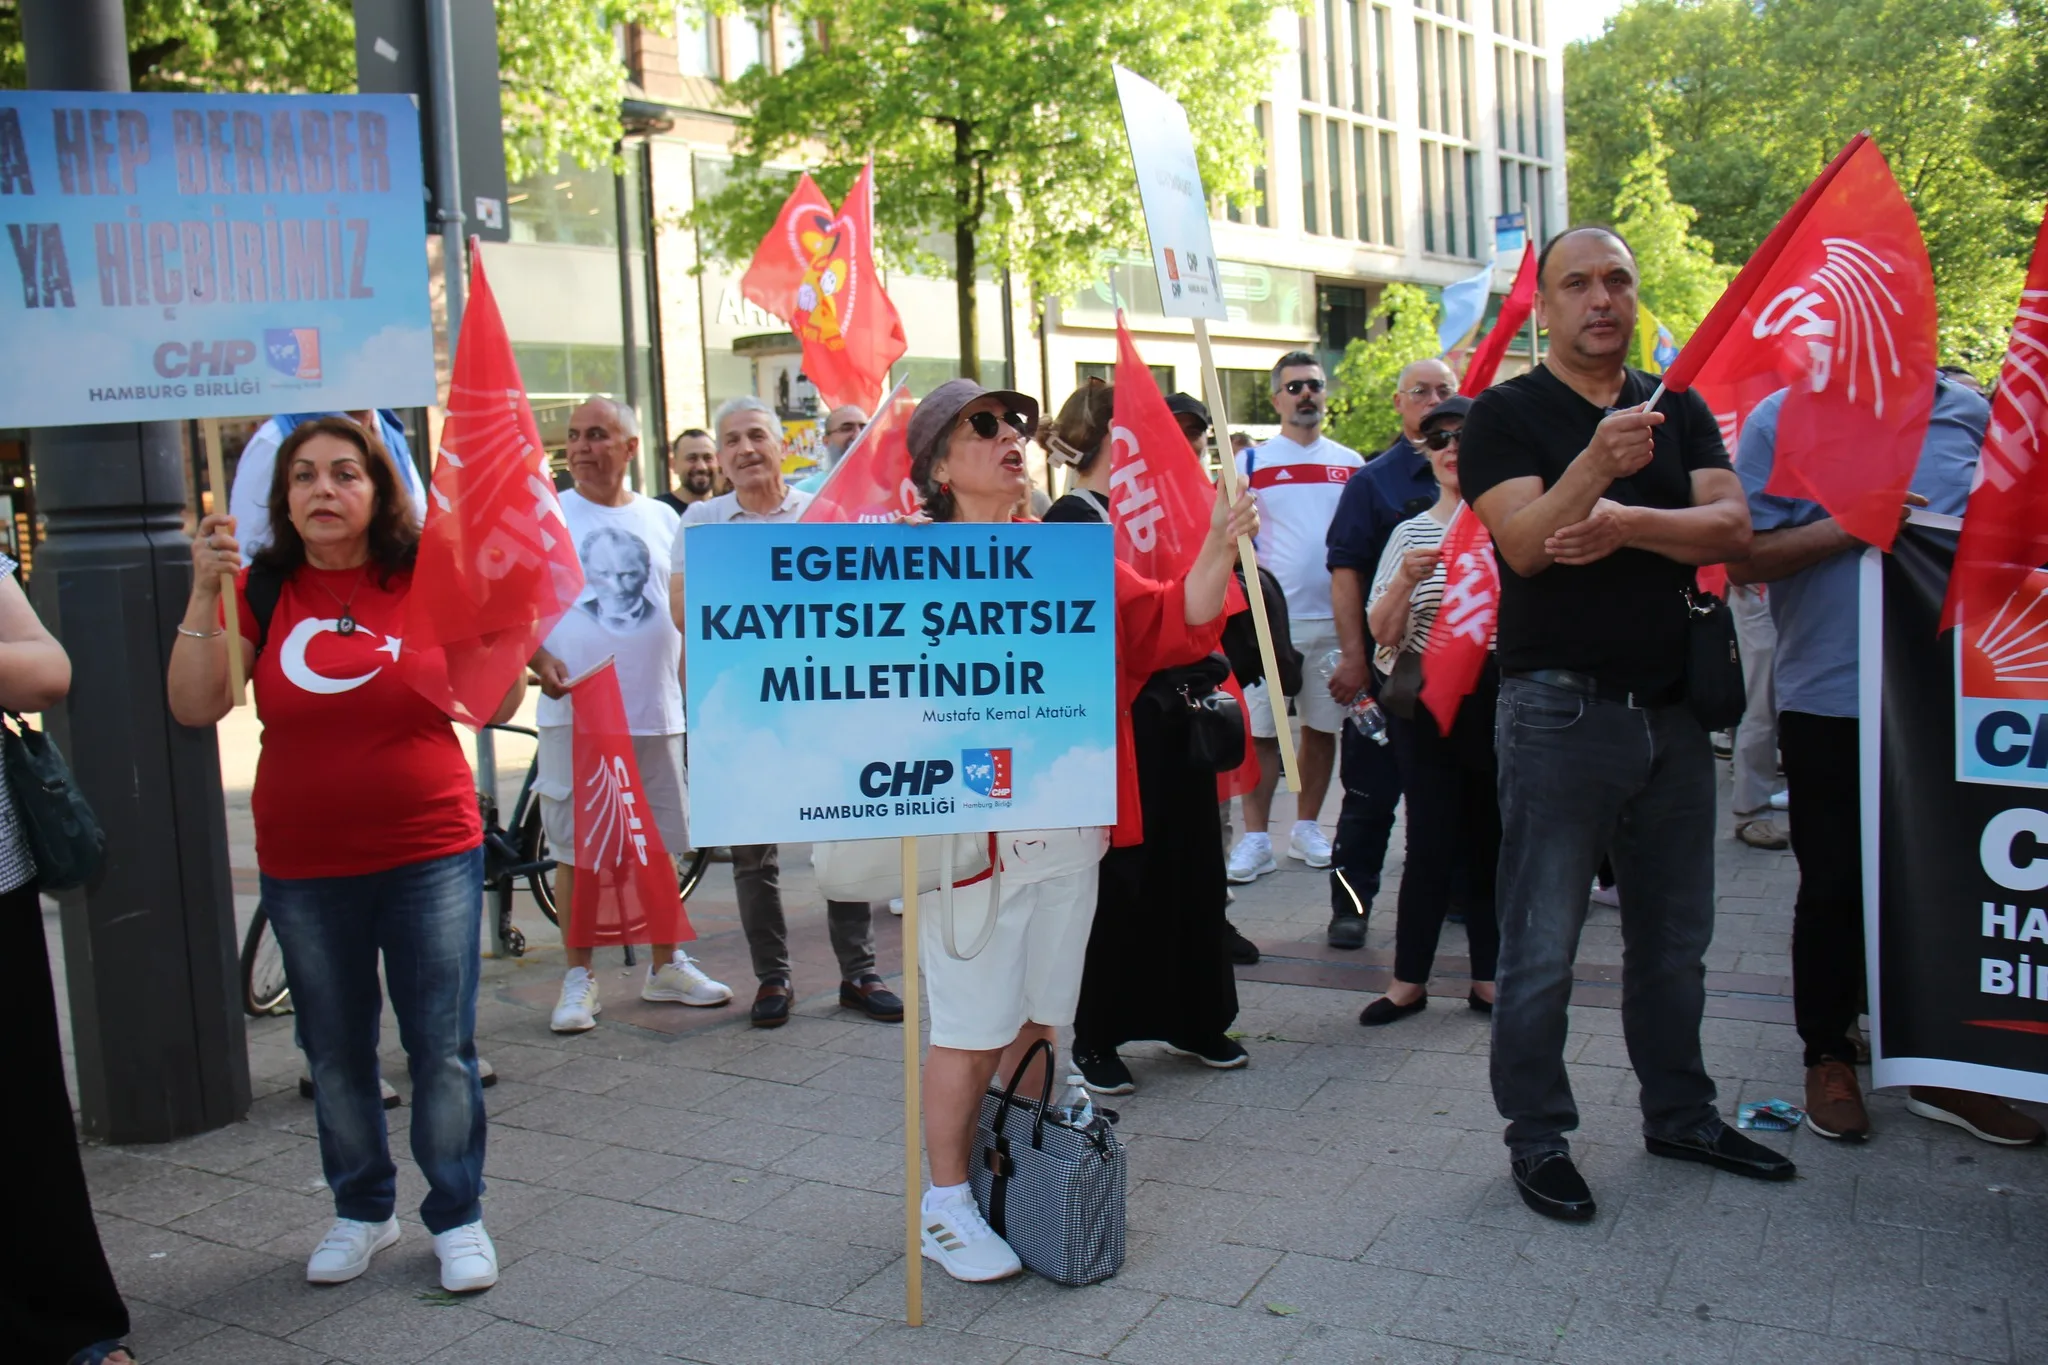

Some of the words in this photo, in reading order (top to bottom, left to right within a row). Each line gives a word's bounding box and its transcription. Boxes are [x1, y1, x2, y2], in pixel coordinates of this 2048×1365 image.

[53, 108, 150, 196] HEP
[173, 109, 391, 195] BERABER
[6, 223, 76, 308] YA
[94, 204, 374, 321] HİÇBİRİMİZ
[153, 339, 257, 379] CHP
[89, 384, 188, 402] HAMBURG
[771, 535, 1033, 582] EGEMENLİK
[702, 603, 905, 641] KAYITSIZ
[922, 599, 1096, 647] ŞARTSIZ
[760, 651, 1045, 702] MİLLETİNDİR
[922, 707, 981, 724] Mustafa
[986, 705, 1031, 721] Kemal
[1035, 704, 1087, 720] Atatürk
[859, 759, 954, 798] CHP
[991, 788, 1011, 797] CHP
[800, 803, 889, 821] HAMBURG
[894, 797, 955, 816] BİRLİĞİ
[962, 801, 993, 809] Hamburg
